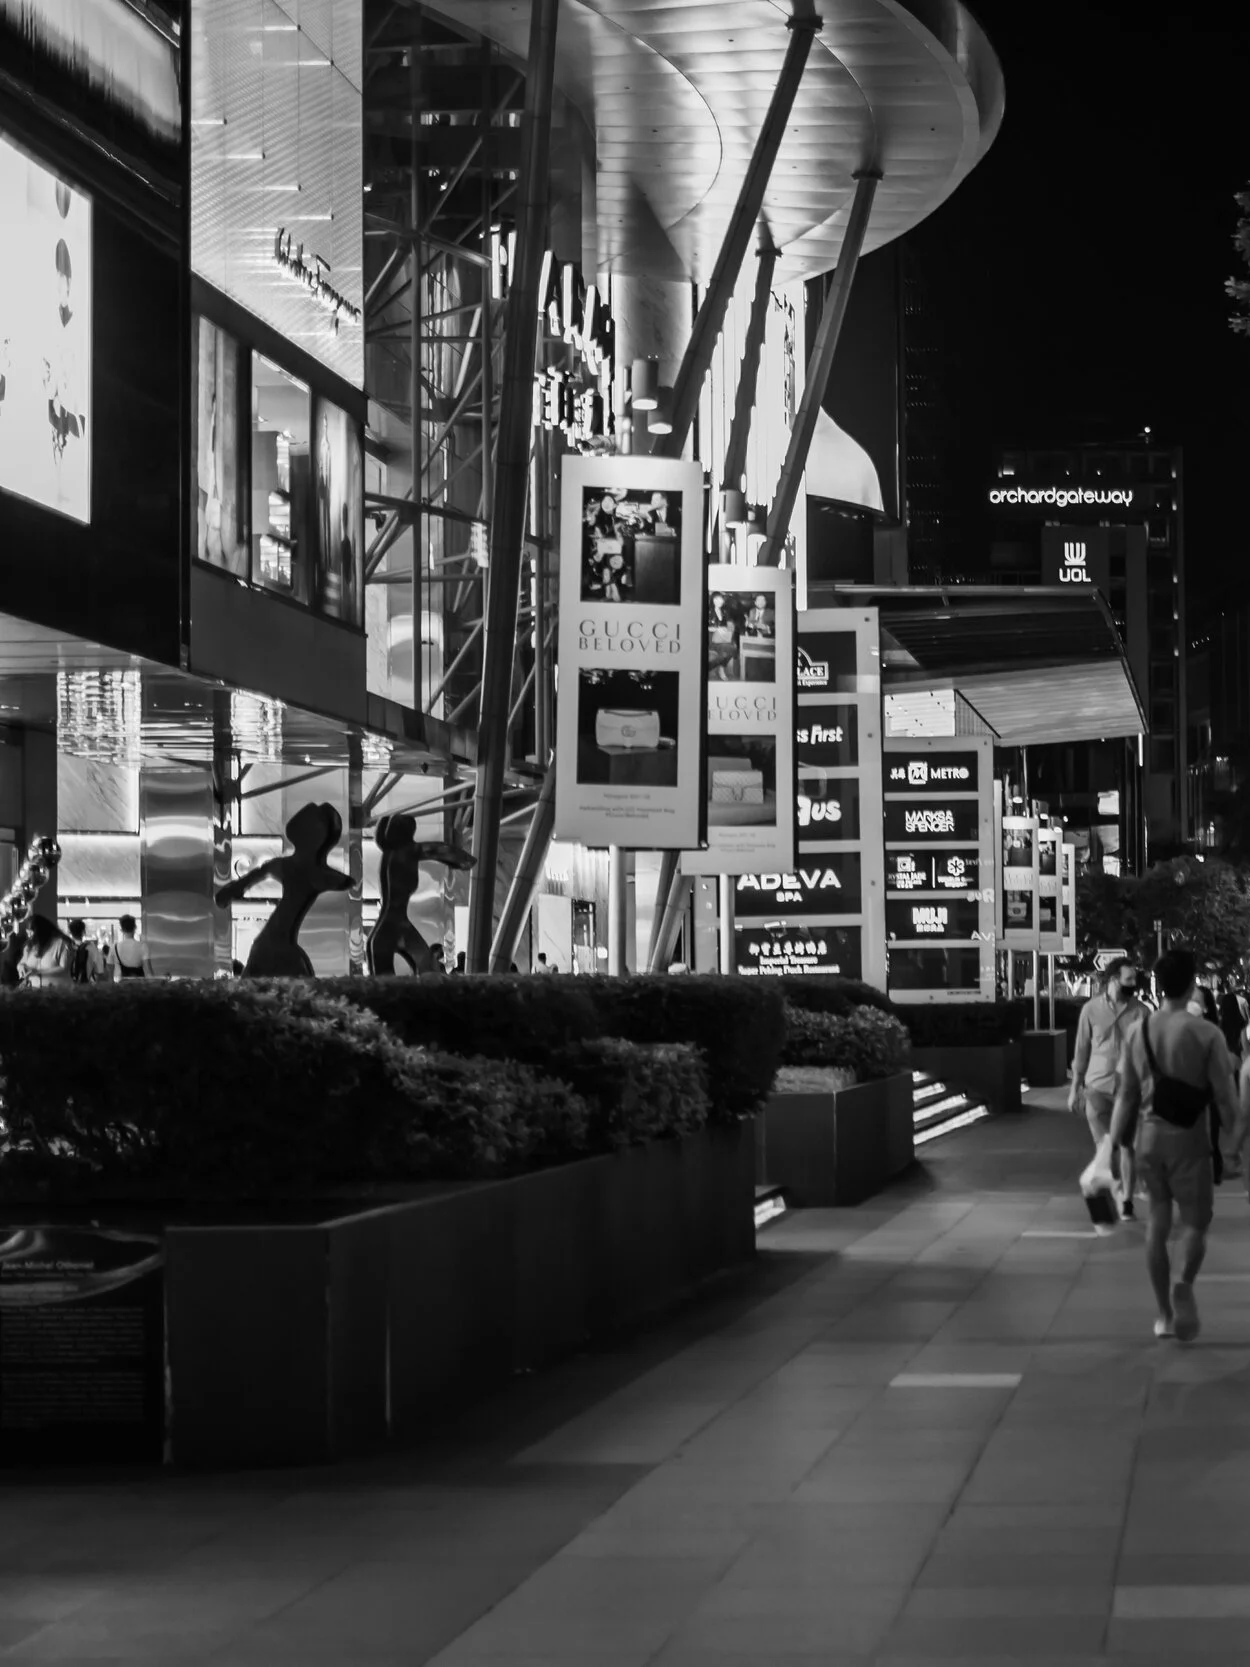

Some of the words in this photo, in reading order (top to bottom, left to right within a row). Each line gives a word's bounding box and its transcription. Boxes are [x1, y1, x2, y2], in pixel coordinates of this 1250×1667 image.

[989, 487, 1133, 507] orchardgateway
[1059, 568, 1092, 583] UOL
[578, 620, 681, 640] GUCCI
[578, 637, 681, 655] BELOVED
[797, 667, 824, 677] LACE
[716, 696, 776, 711] UCCI
[708, 709, 777, 721] ELOVED
[930, 768, 969, 779] METRO
[905, 821, 955, 833] SPENCER
[737, 869, 842, 891] ADEVA
[776, 892, 803, 902] SPA
[912, 907, 948, 924] MUJI
